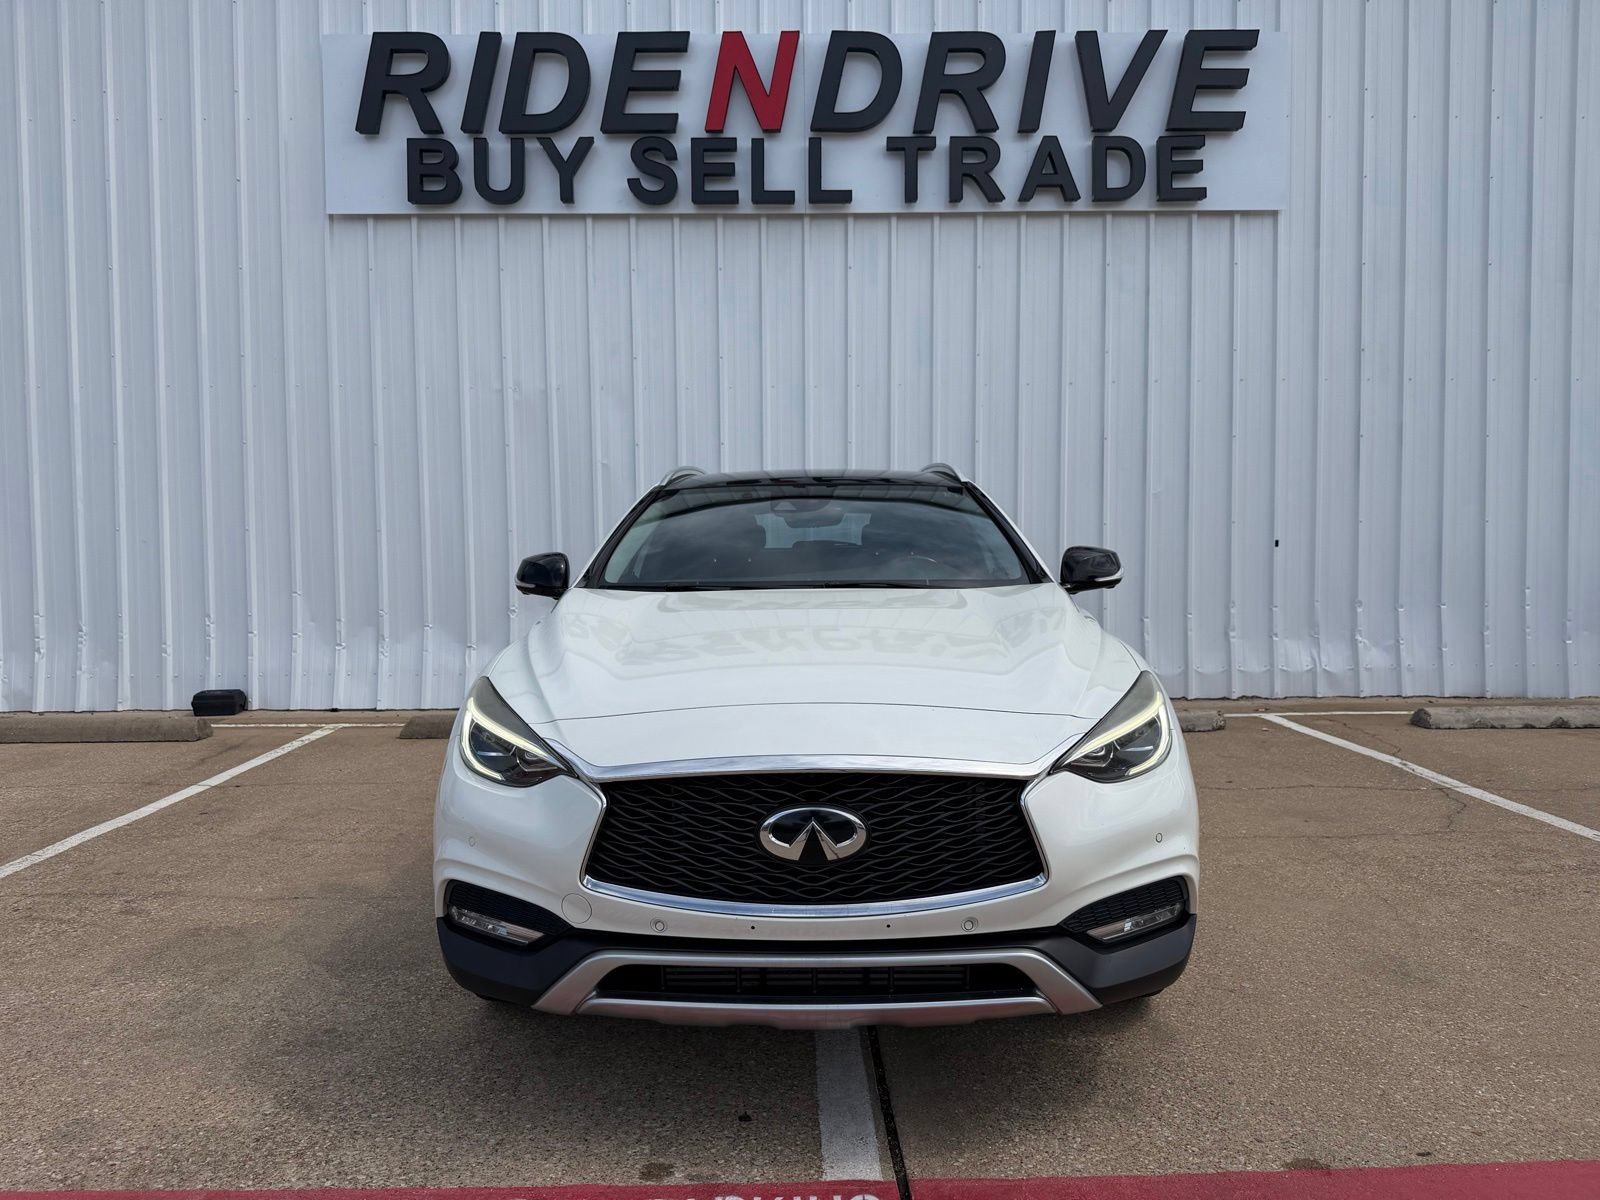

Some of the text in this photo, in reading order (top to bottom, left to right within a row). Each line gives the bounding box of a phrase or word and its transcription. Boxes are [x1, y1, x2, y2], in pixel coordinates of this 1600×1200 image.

[407, 136, 1207, 205] BUY SELL TRADE
